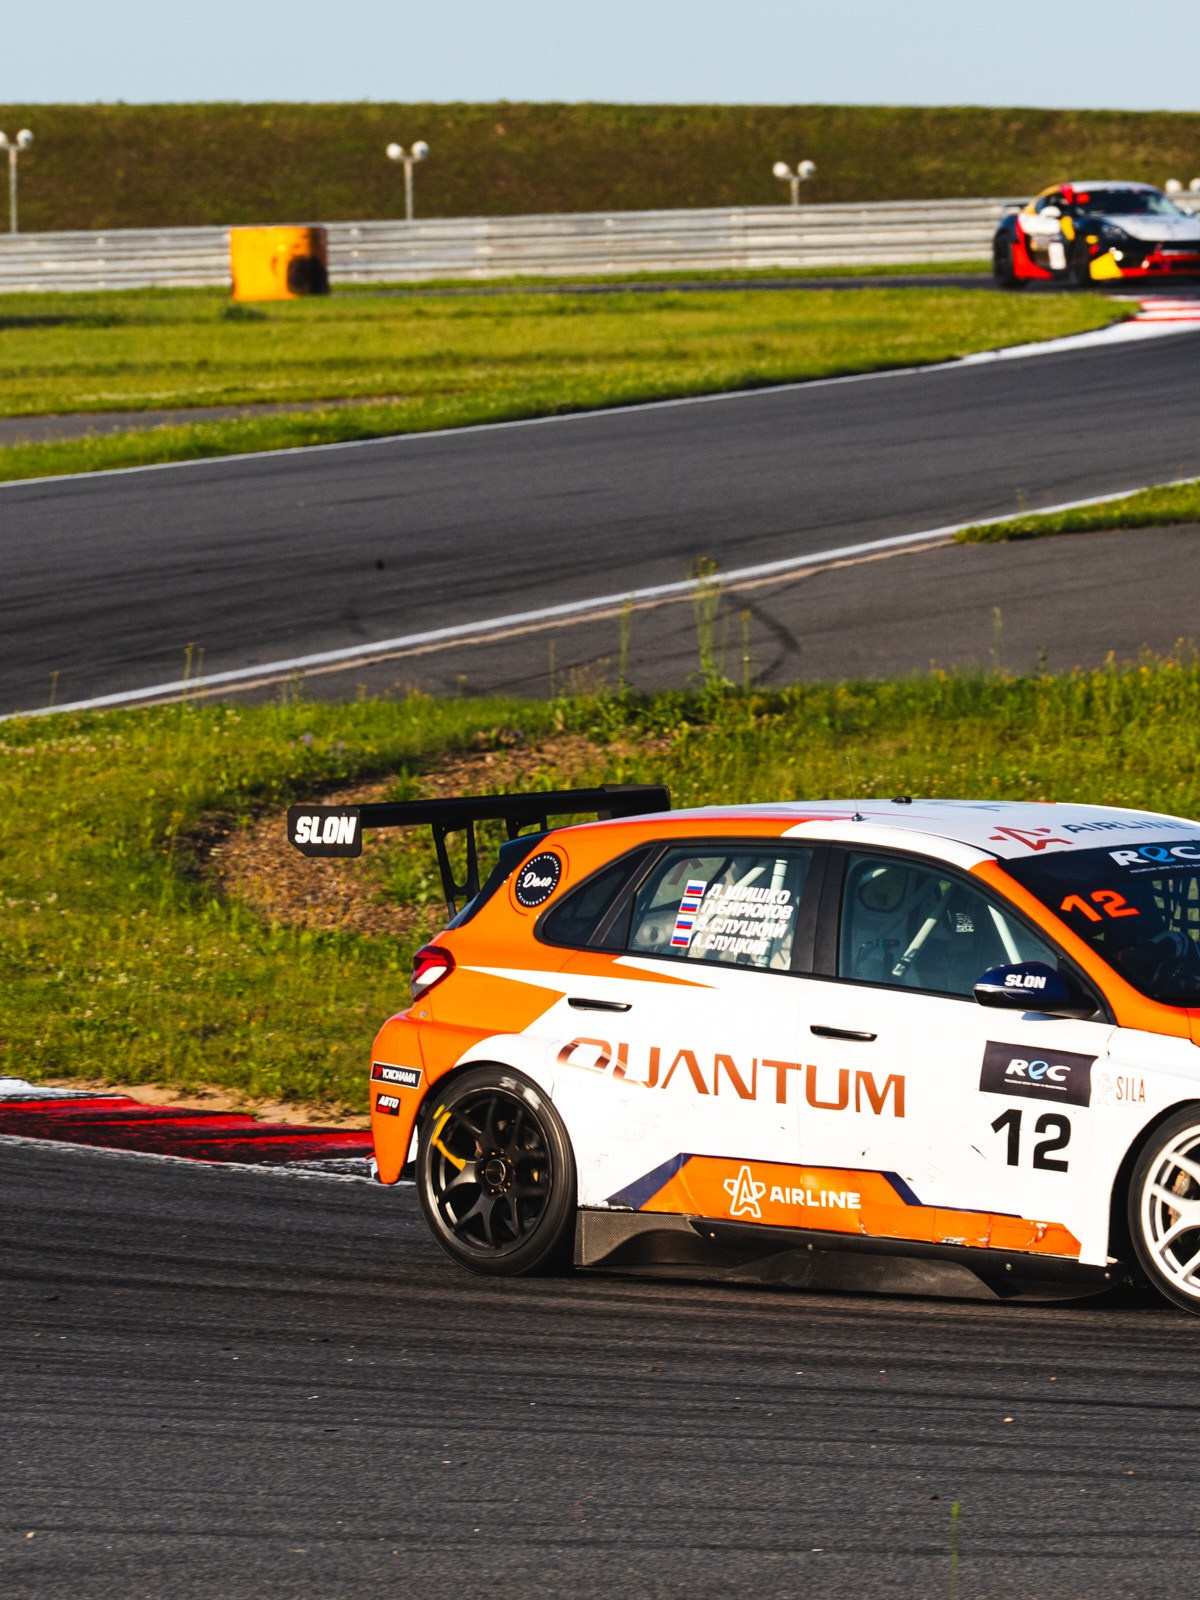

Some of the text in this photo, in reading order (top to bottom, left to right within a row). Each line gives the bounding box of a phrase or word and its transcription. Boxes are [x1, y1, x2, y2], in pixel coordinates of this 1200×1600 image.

[295, 816, 357, 844] SLON
[1062, 820, 1196, 834] AIRLINE
[1060, 889, 1141, 923] 12
[1004, 974, 1047, 989] SLON
[382, 1067, 416, 1084] YOKOHAMA
[557, 1037, 905, 1118] QUANTUM
[1116, 1075, 1146, 1103] SILA
[990, 1108, 1072, 1173] 12
[770, 1185, 862, 1210] AIRLINE
